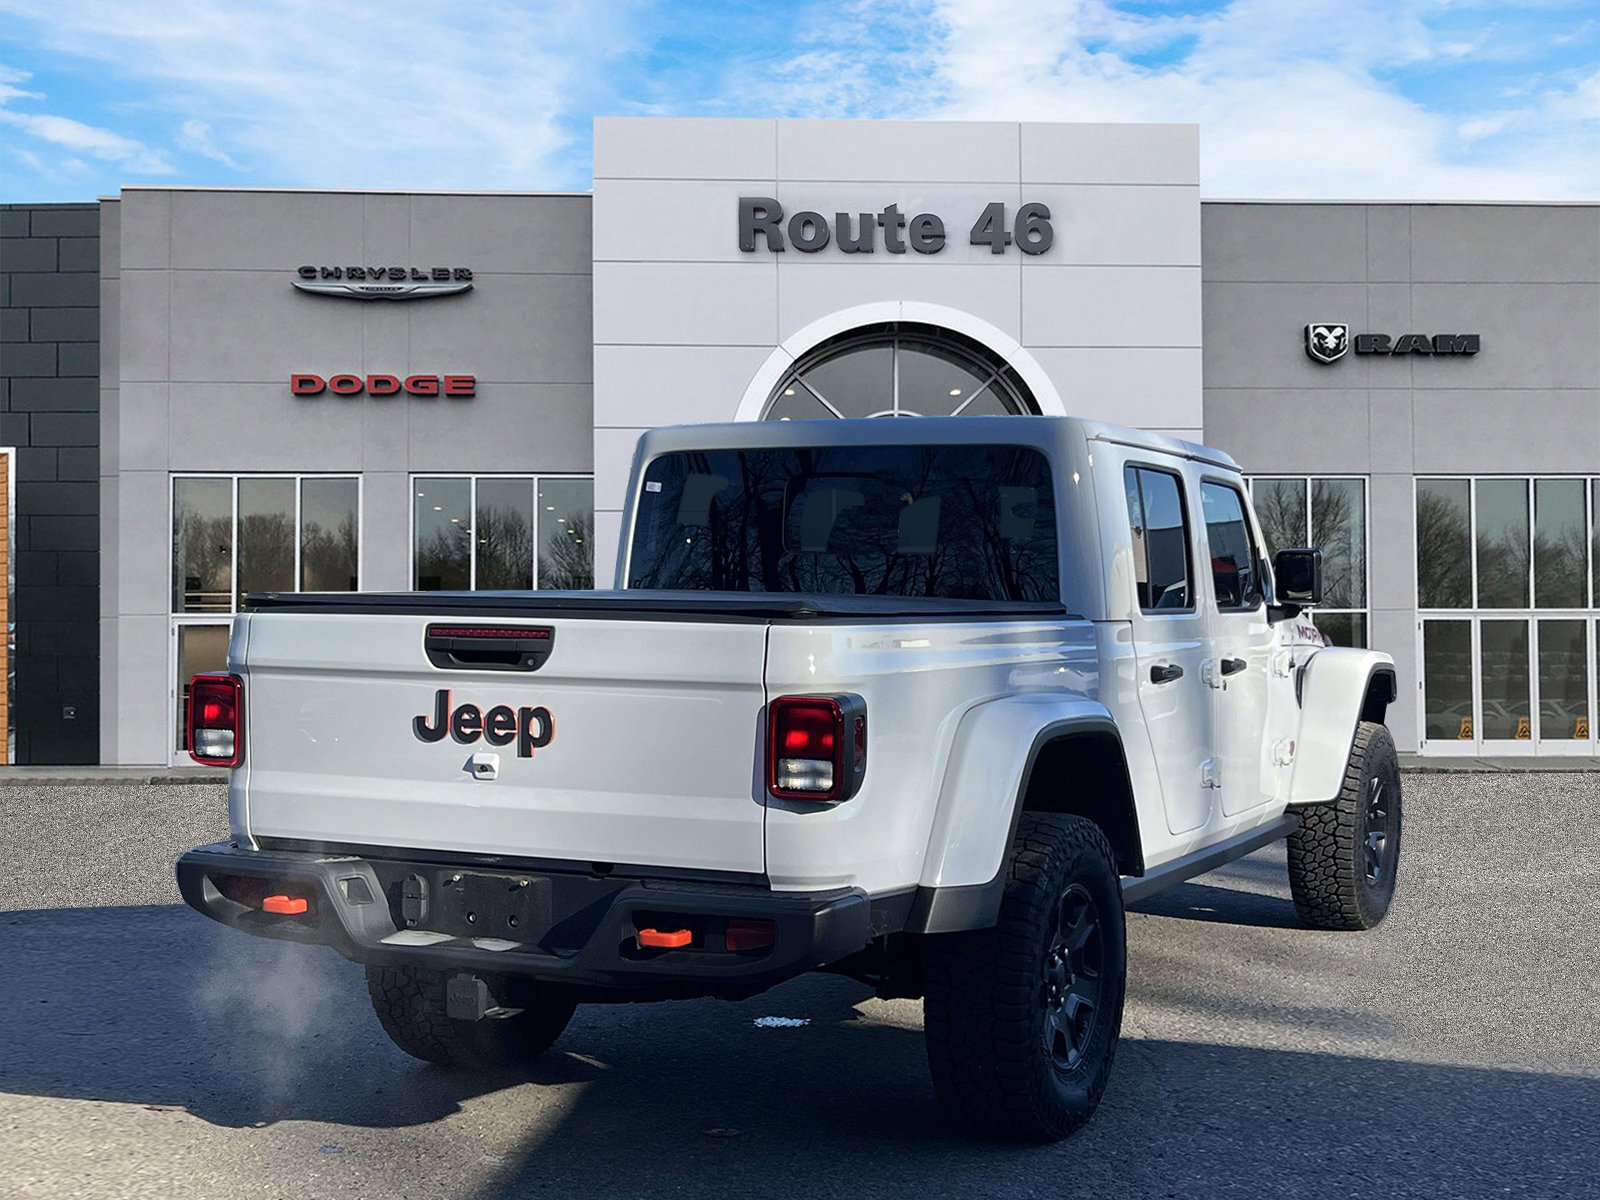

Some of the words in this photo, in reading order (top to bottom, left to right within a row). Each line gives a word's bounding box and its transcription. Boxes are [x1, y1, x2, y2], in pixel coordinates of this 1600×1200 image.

[738, 197, 946, 254] Route
[969, 202, 1054, 255] 46
[298, 265, 474, 281] CHRYSLER
[1354, 334, 1480, 356] RAM
[290, 374, 476, 397] DODGE
[412, 689, 555, 758] Jeep
